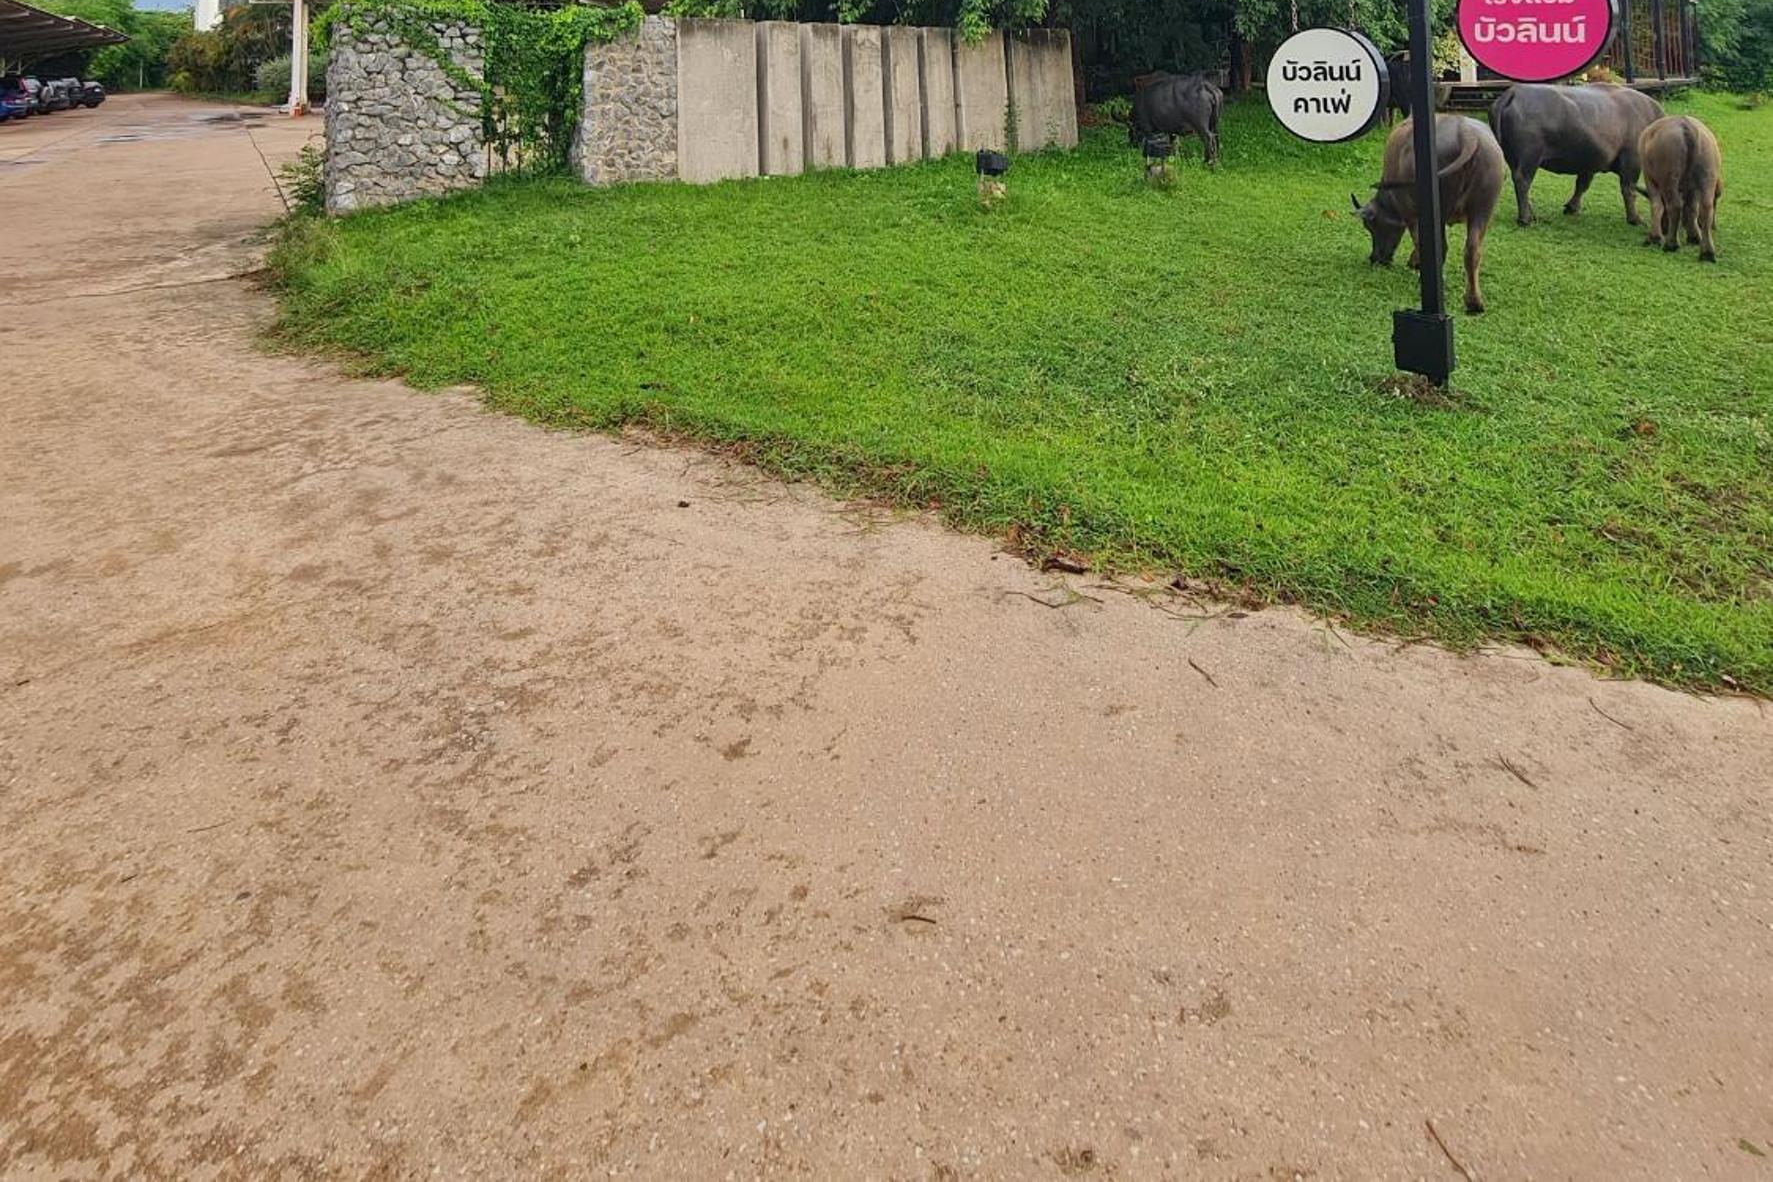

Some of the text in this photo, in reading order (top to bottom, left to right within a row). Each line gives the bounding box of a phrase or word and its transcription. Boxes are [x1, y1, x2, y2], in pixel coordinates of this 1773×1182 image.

[1474, 15, 1586, 43] บัวลินน์
[1282, 59, 1361, 81] บัวลินน์
[1293, 88, 1351, 114] คาเฟ่
